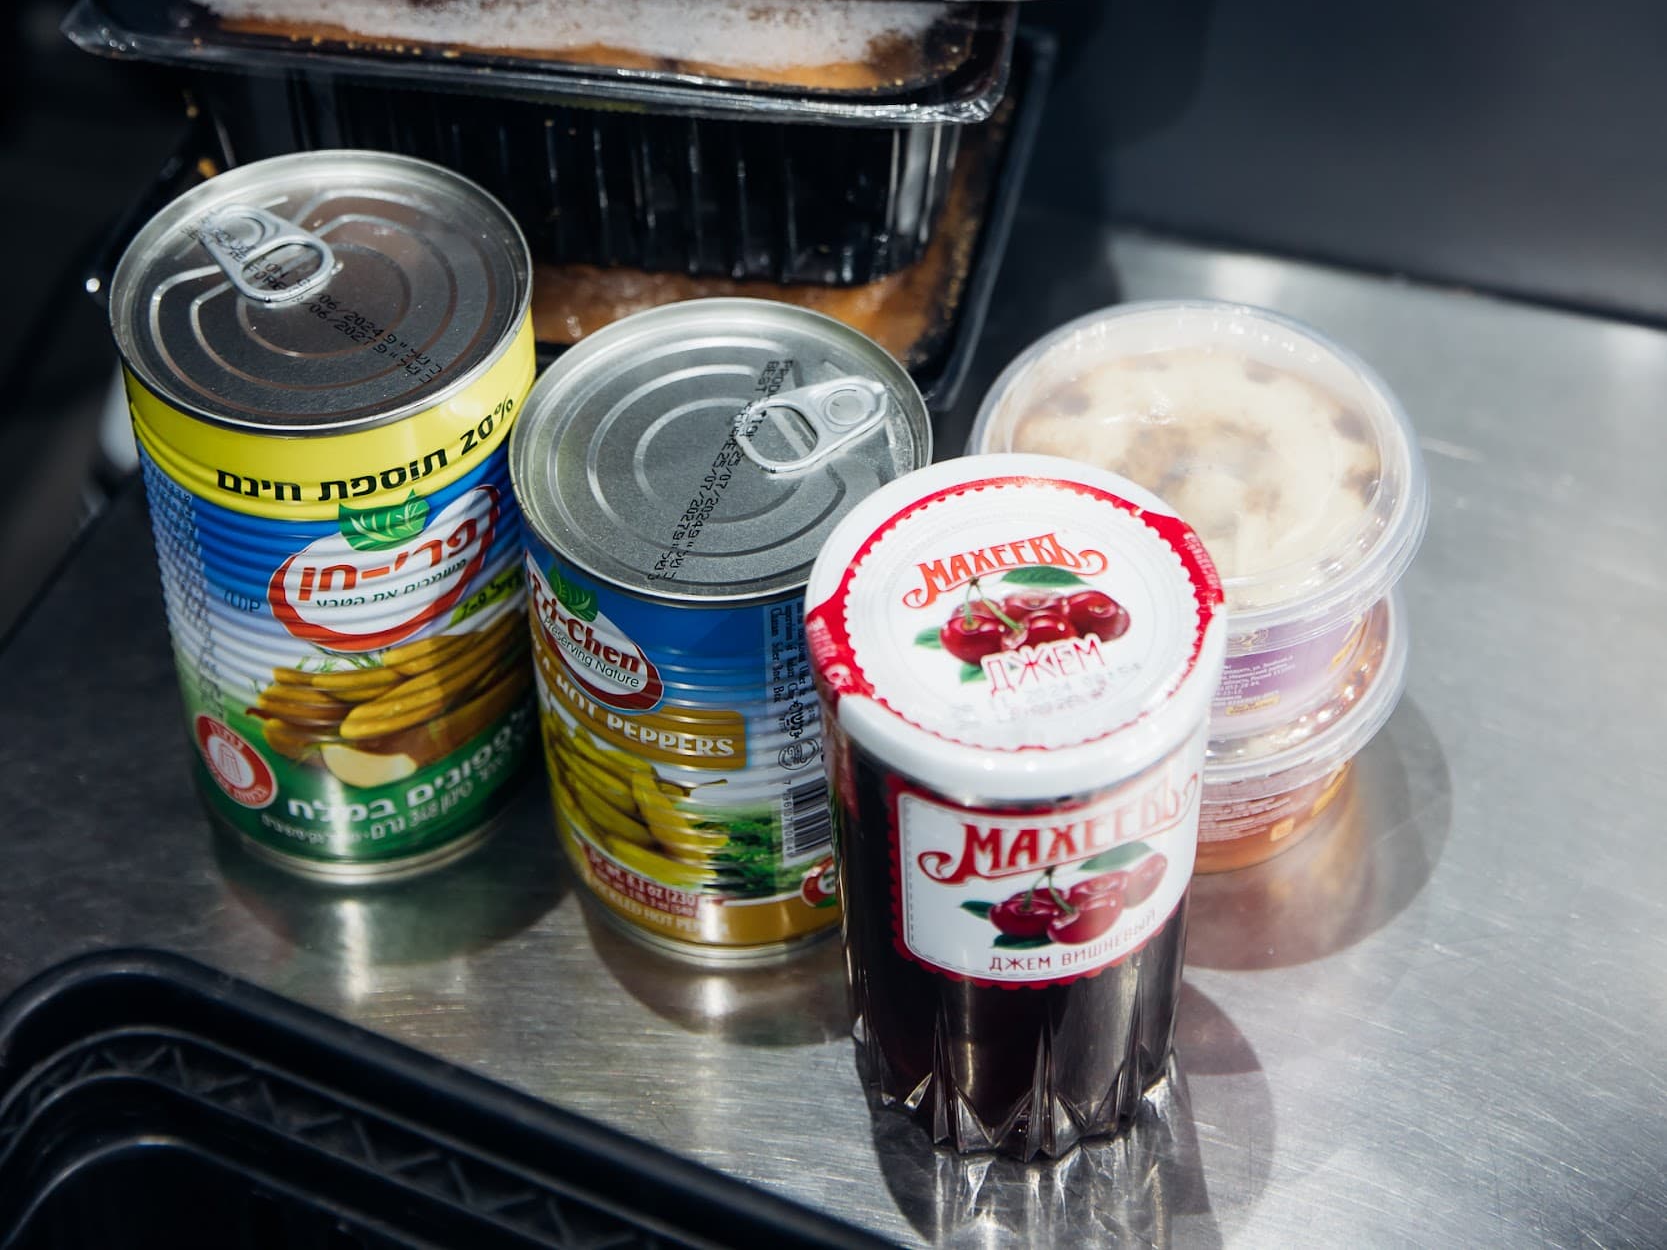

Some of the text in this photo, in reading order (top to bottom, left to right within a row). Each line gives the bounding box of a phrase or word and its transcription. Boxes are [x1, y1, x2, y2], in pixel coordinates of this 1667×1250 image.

[216, 395, 514, 502] 20% תוספת חינם
[676, 452, 728, 532] 25/07/2027
[543, 616, 594, 669] Preserving
[593, 657, 641, 689] Nature
[985, 634, 1107, 698] ДЖЕМ
[606, 713, 736, 759] PEPPERS
[988, 955, 1051, 972] ДЖЕМ
